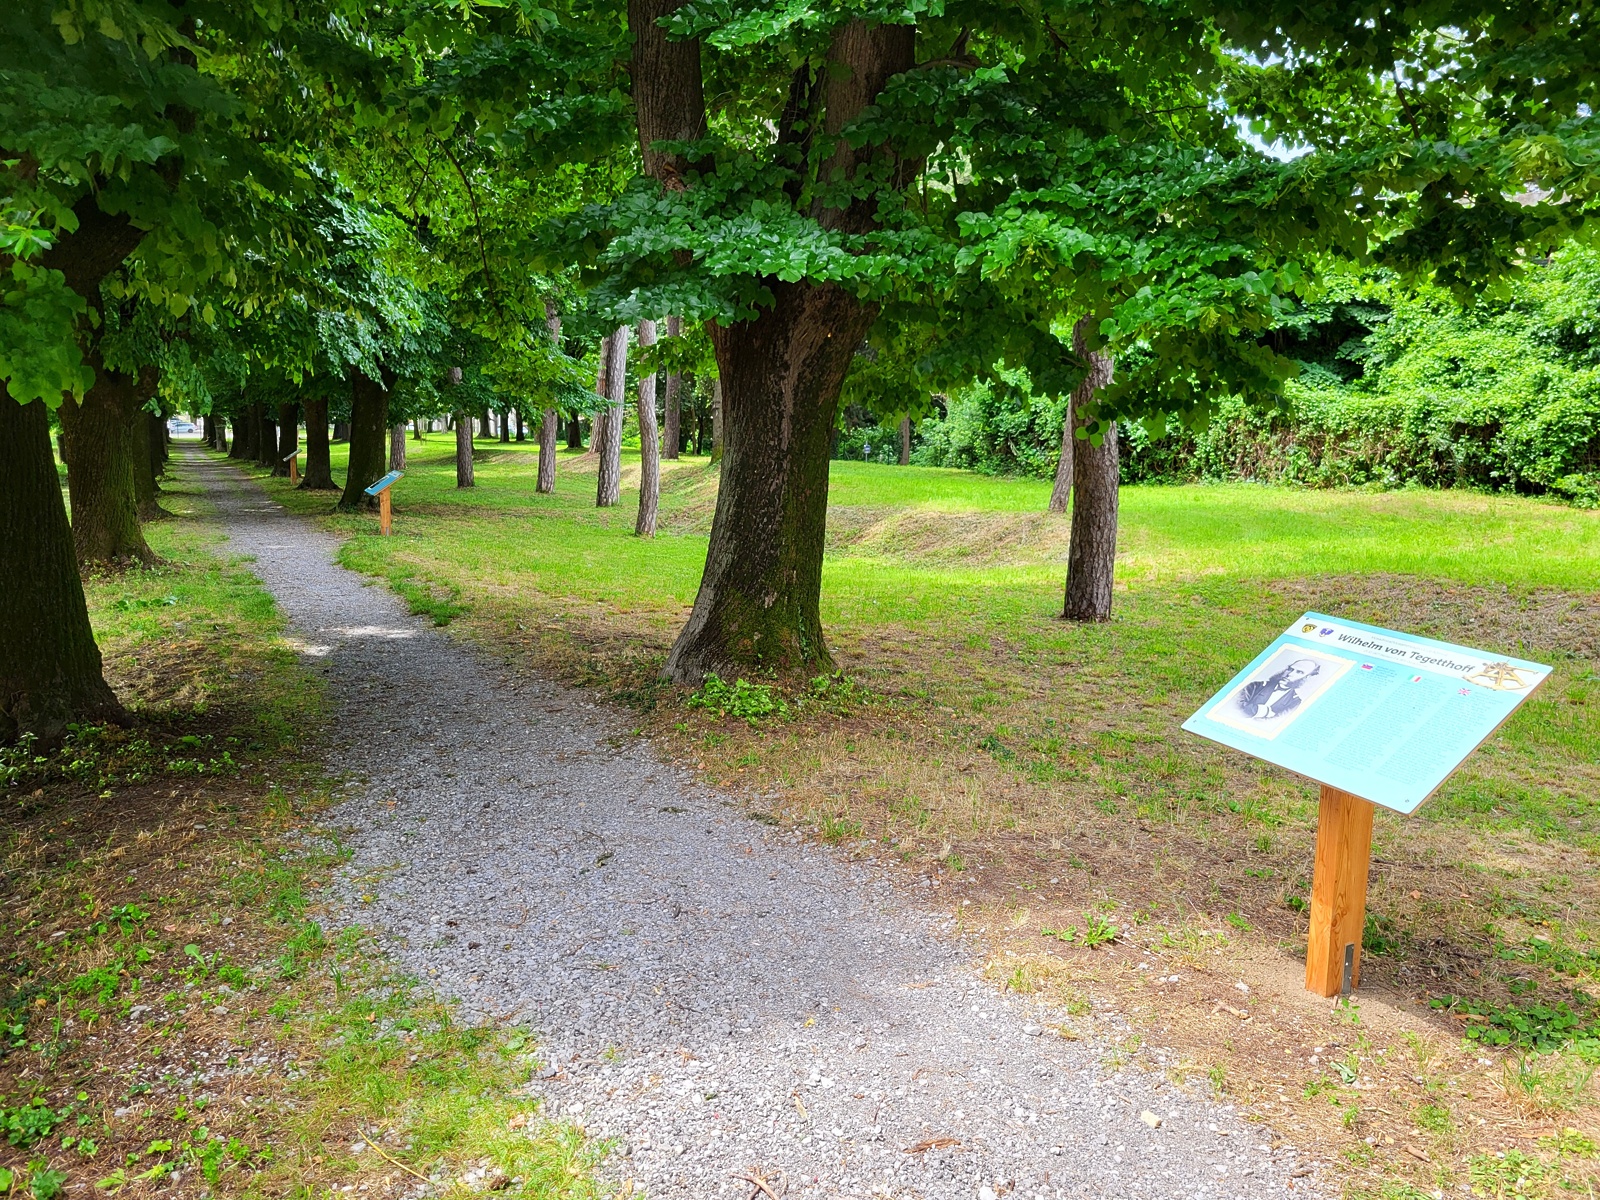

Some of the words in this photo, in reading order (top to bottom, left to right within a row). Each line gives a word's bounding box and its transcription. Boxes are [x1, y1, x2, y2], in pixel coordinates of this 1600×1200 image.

[1338, 633, 1383, 651] Wilhelm
[1384, 646, 1407, 657] von
[1409, 651, 1475, 673] Tegetthoff
